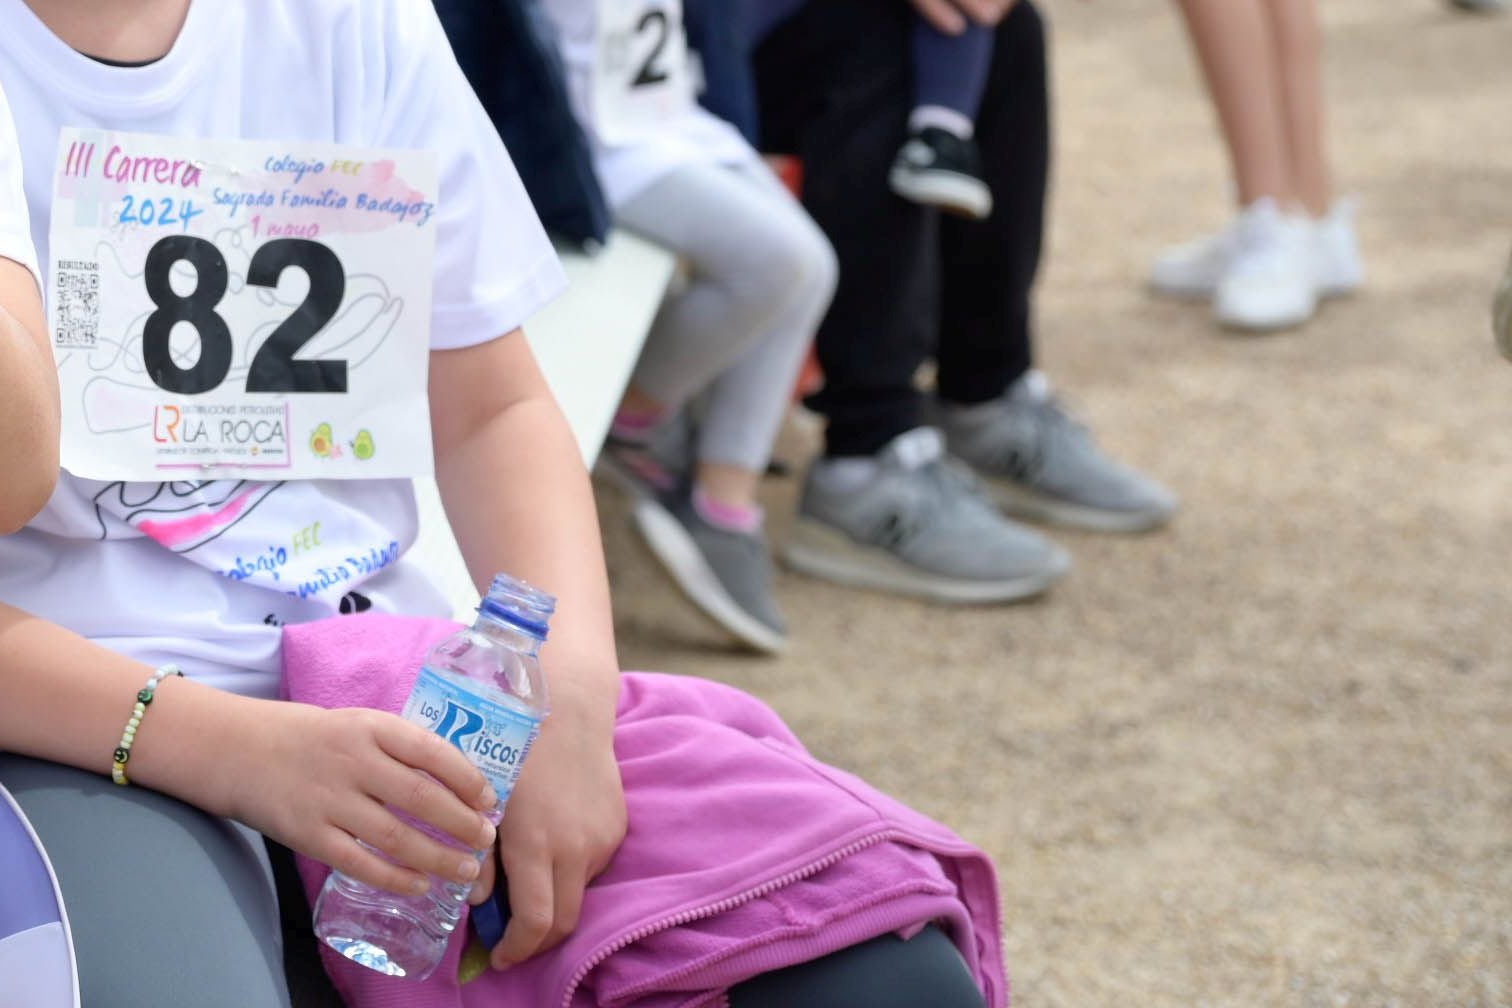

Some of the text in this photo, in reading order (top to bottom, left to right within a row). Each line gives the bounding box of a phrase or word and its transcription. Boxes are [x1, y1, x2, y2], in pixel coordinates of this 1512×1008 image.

[65, 141, 201, 187] III Carrera
[264, 154, 325, 184] Colegio
[119, 194, 205, 230] 2024
[213, 187, 435, 227] Sagrada Familia Badajoz
[251, 214, 262, 238] 1
[143, 235, 349, 395] 82
[183, 420, 285, 444] LA ROCA
